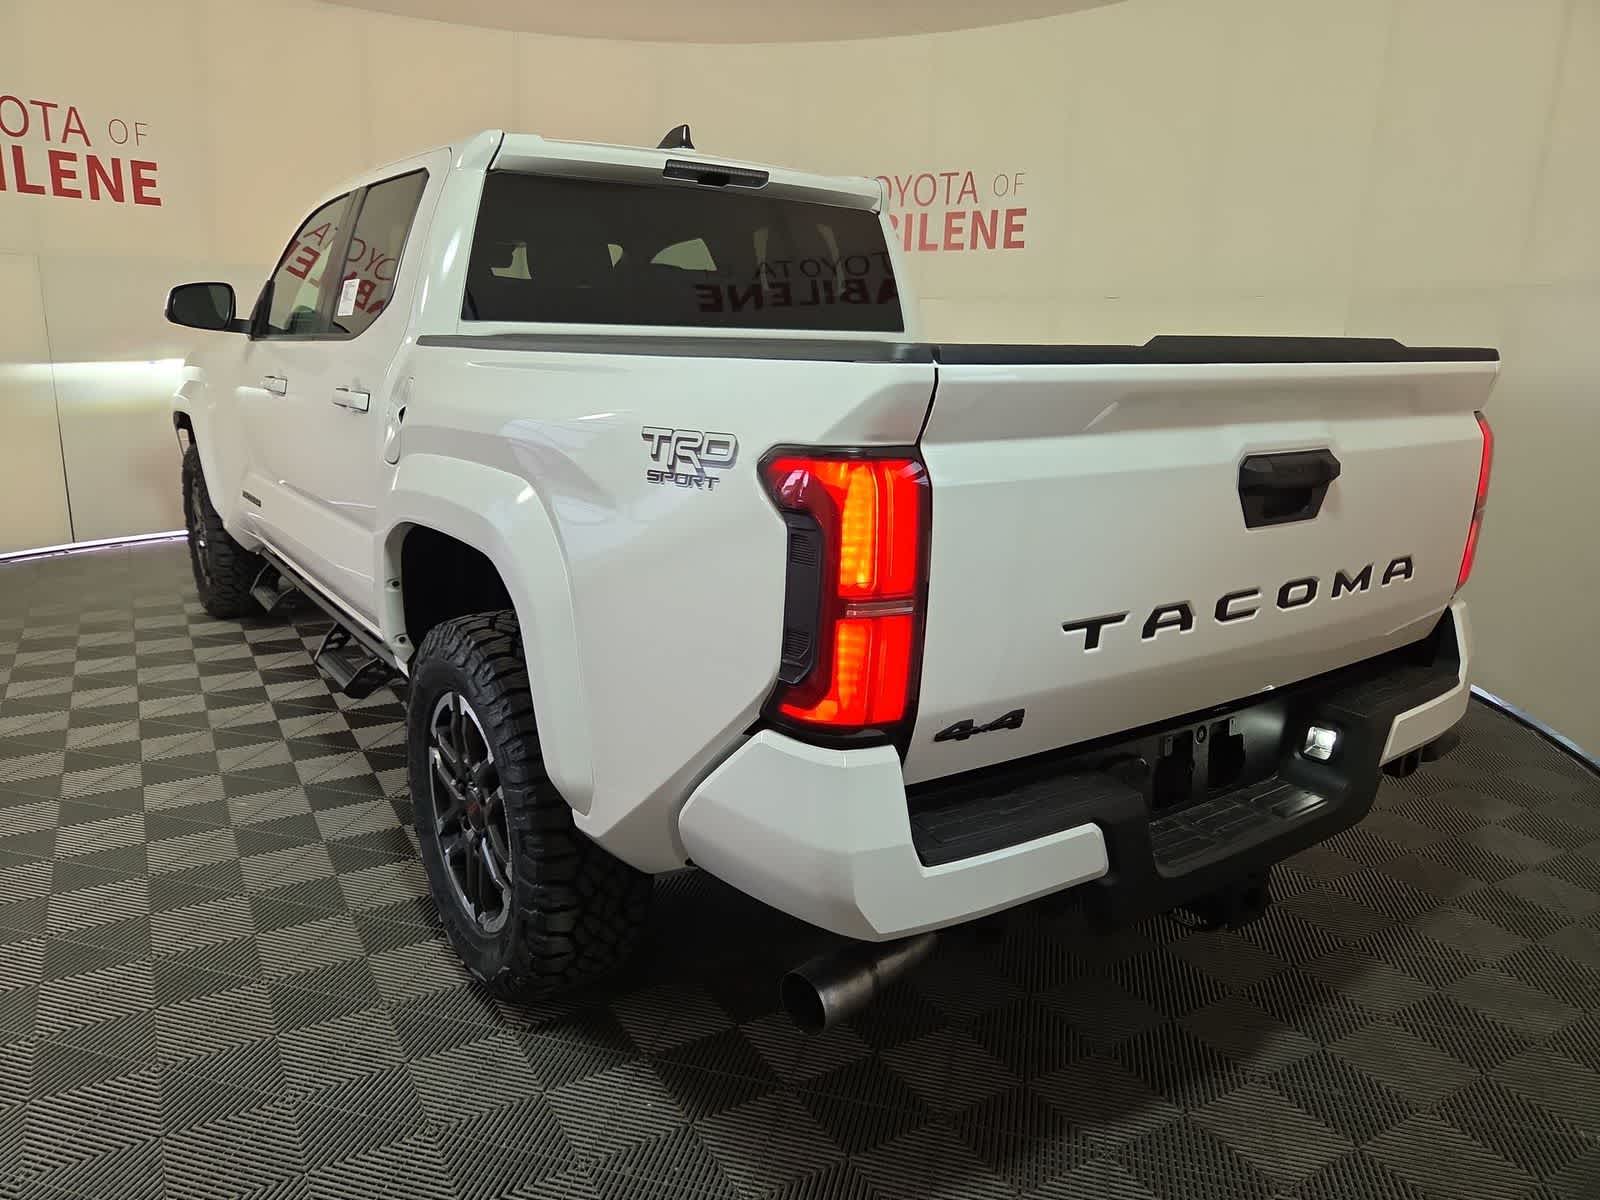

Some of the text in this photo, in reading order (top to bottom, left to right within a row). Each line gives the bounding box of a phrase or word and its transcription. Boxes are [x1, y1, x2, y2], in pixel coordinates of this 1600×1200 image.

[108, 118, 149, 146] OF
[993, 172, 1025, 197] OF
[890, 208, 1027, 251] ILENE
[641, 425, 739, 471] TRD
[646, 469, 720, 491] SPORT
[1061, 554, 1413, 652] TACOMA
